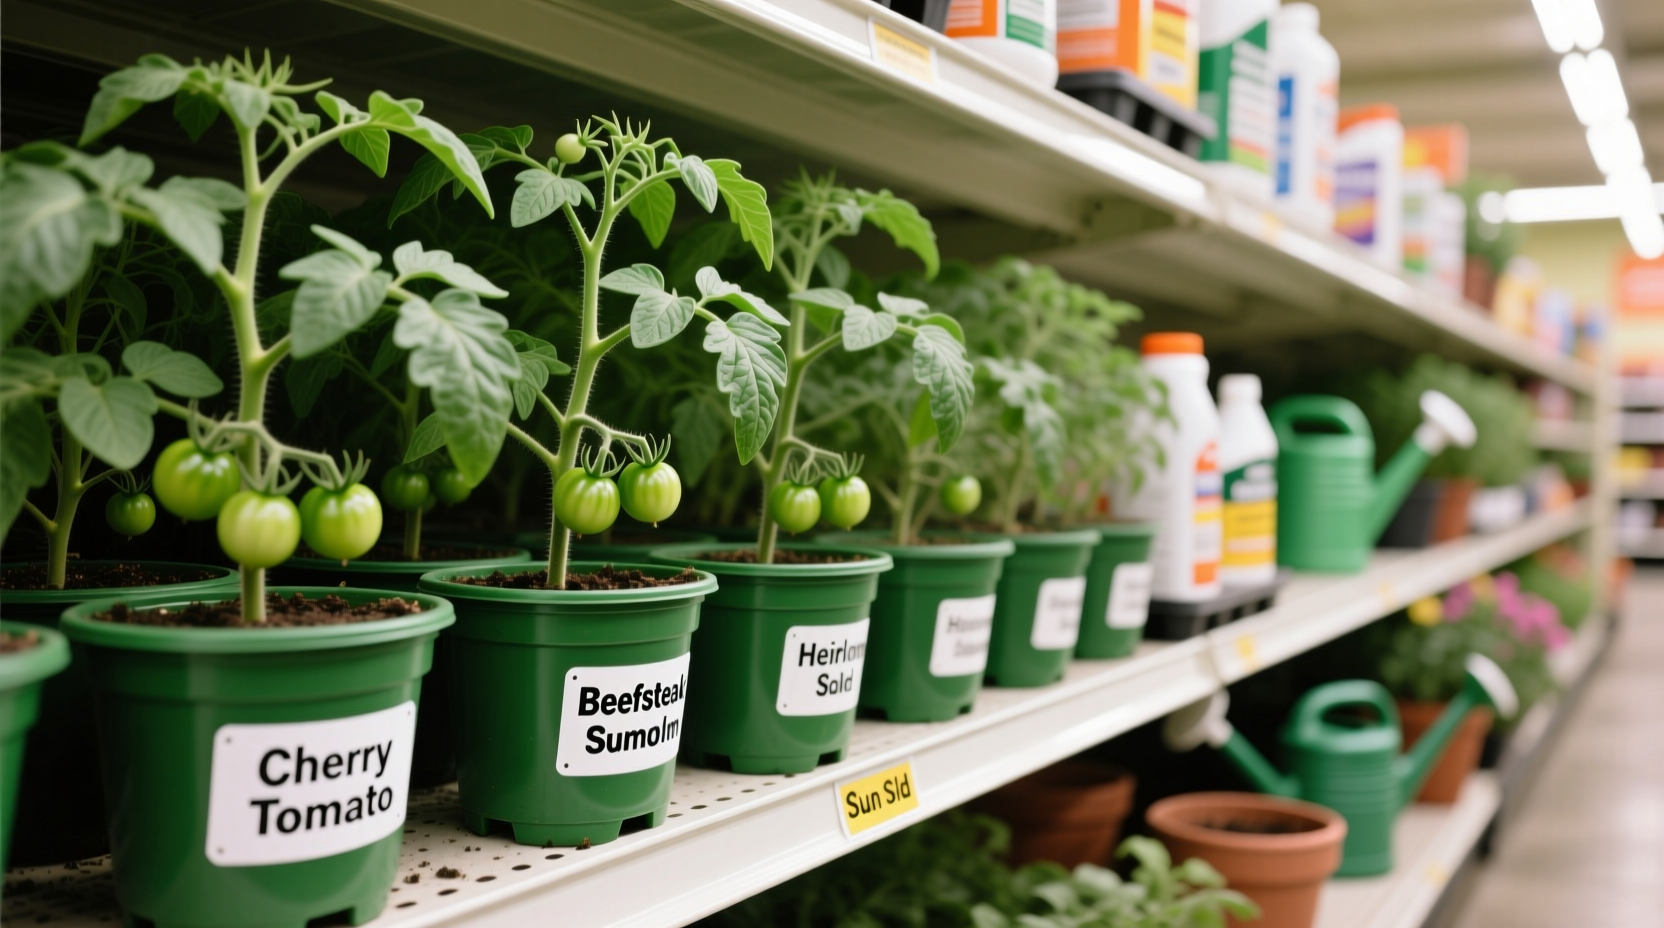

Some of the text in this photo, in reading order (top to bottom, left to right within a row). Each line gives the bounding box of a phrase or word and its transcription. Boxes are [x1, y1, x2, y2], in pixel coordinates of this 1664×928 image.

[258, 740, 392, 787] Cherry
[250, 785, 393, 835] Tomato
[846, 791, 882, 819] Sun
